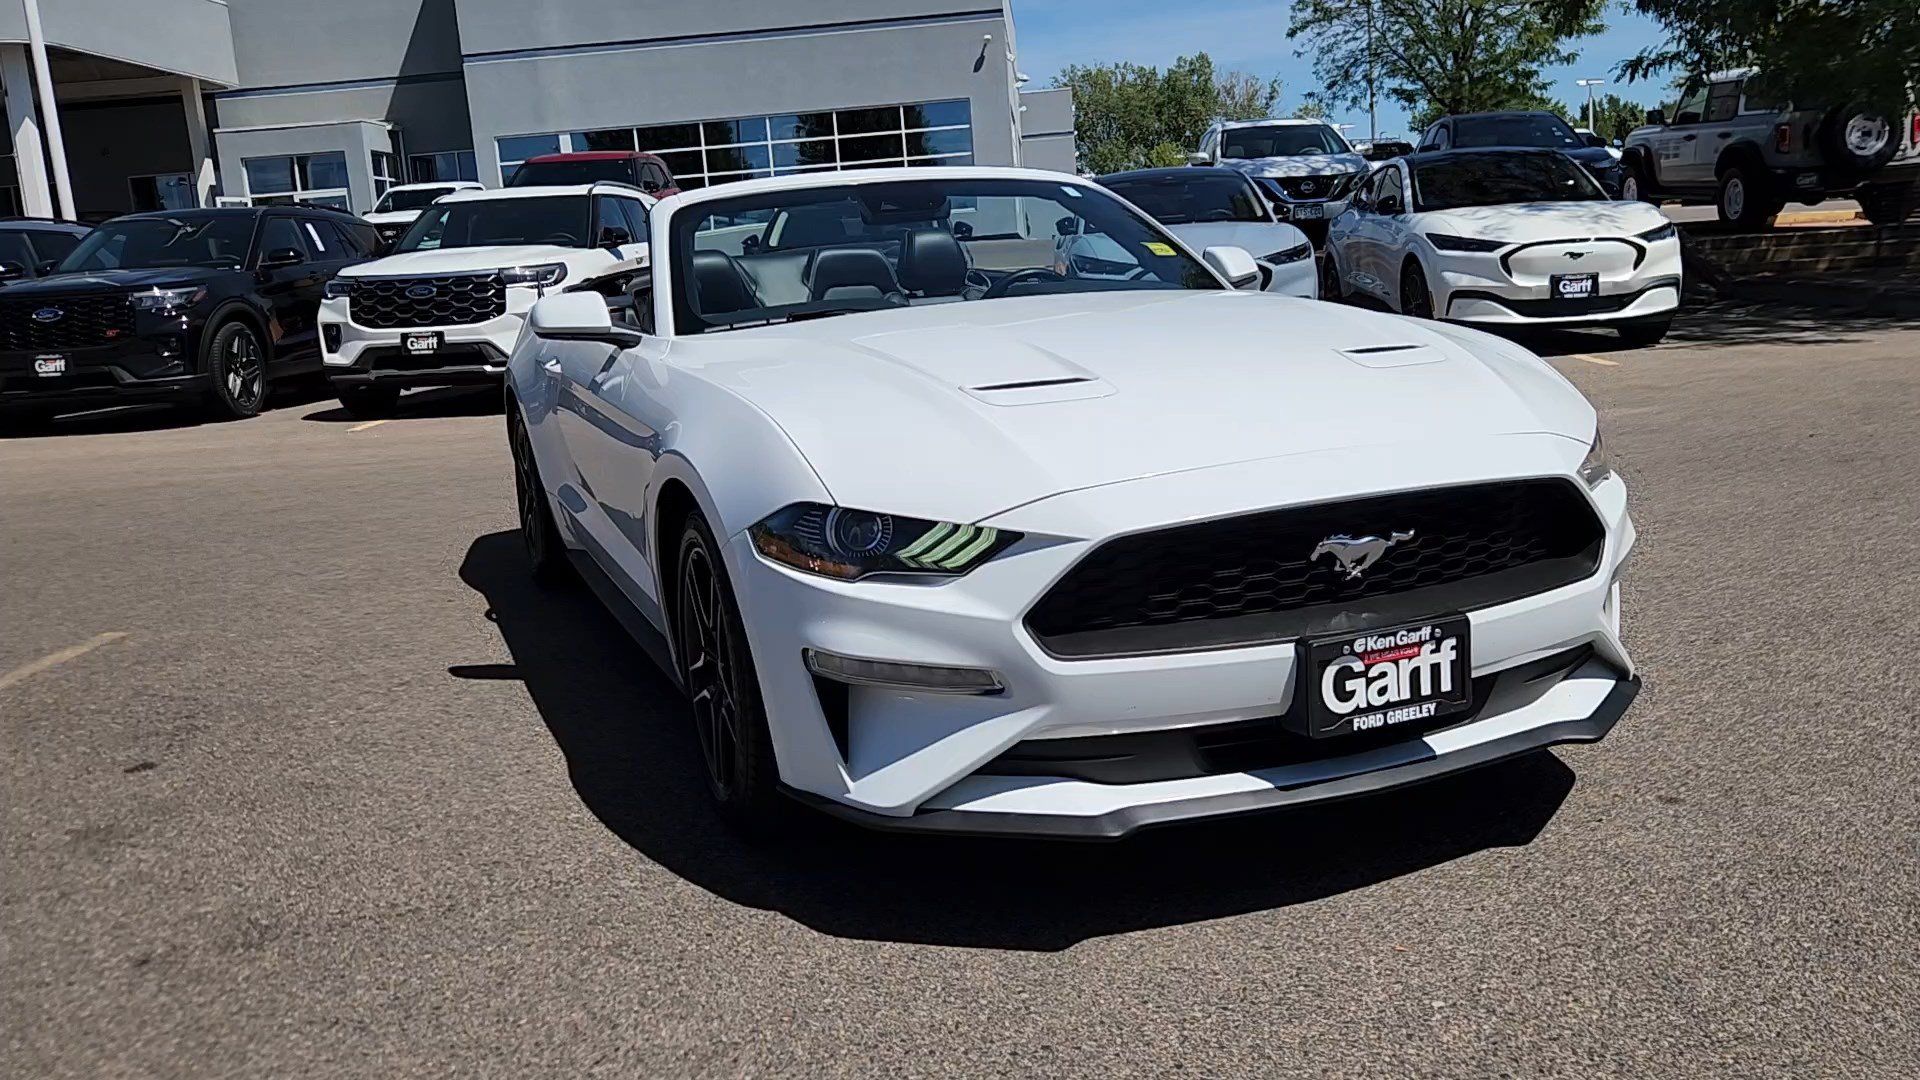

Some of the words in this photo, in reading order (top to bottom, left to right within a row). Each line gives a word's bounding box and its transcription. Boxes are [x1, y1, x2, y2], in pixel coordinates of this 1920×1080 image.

[1559, 279, 1592, 293] Garff
[407, 336, 438, 351] Garff
[35, 359, 66, 373] Garff
[1367, 635, 1395, 651] Ken
[1396, 626, 1432, 645] Garff
[1321, 637, 1457, 715] Garff
[1353, 713, 1384, 731] FORD
[1386, 702, 1437, 724] GREELEY
